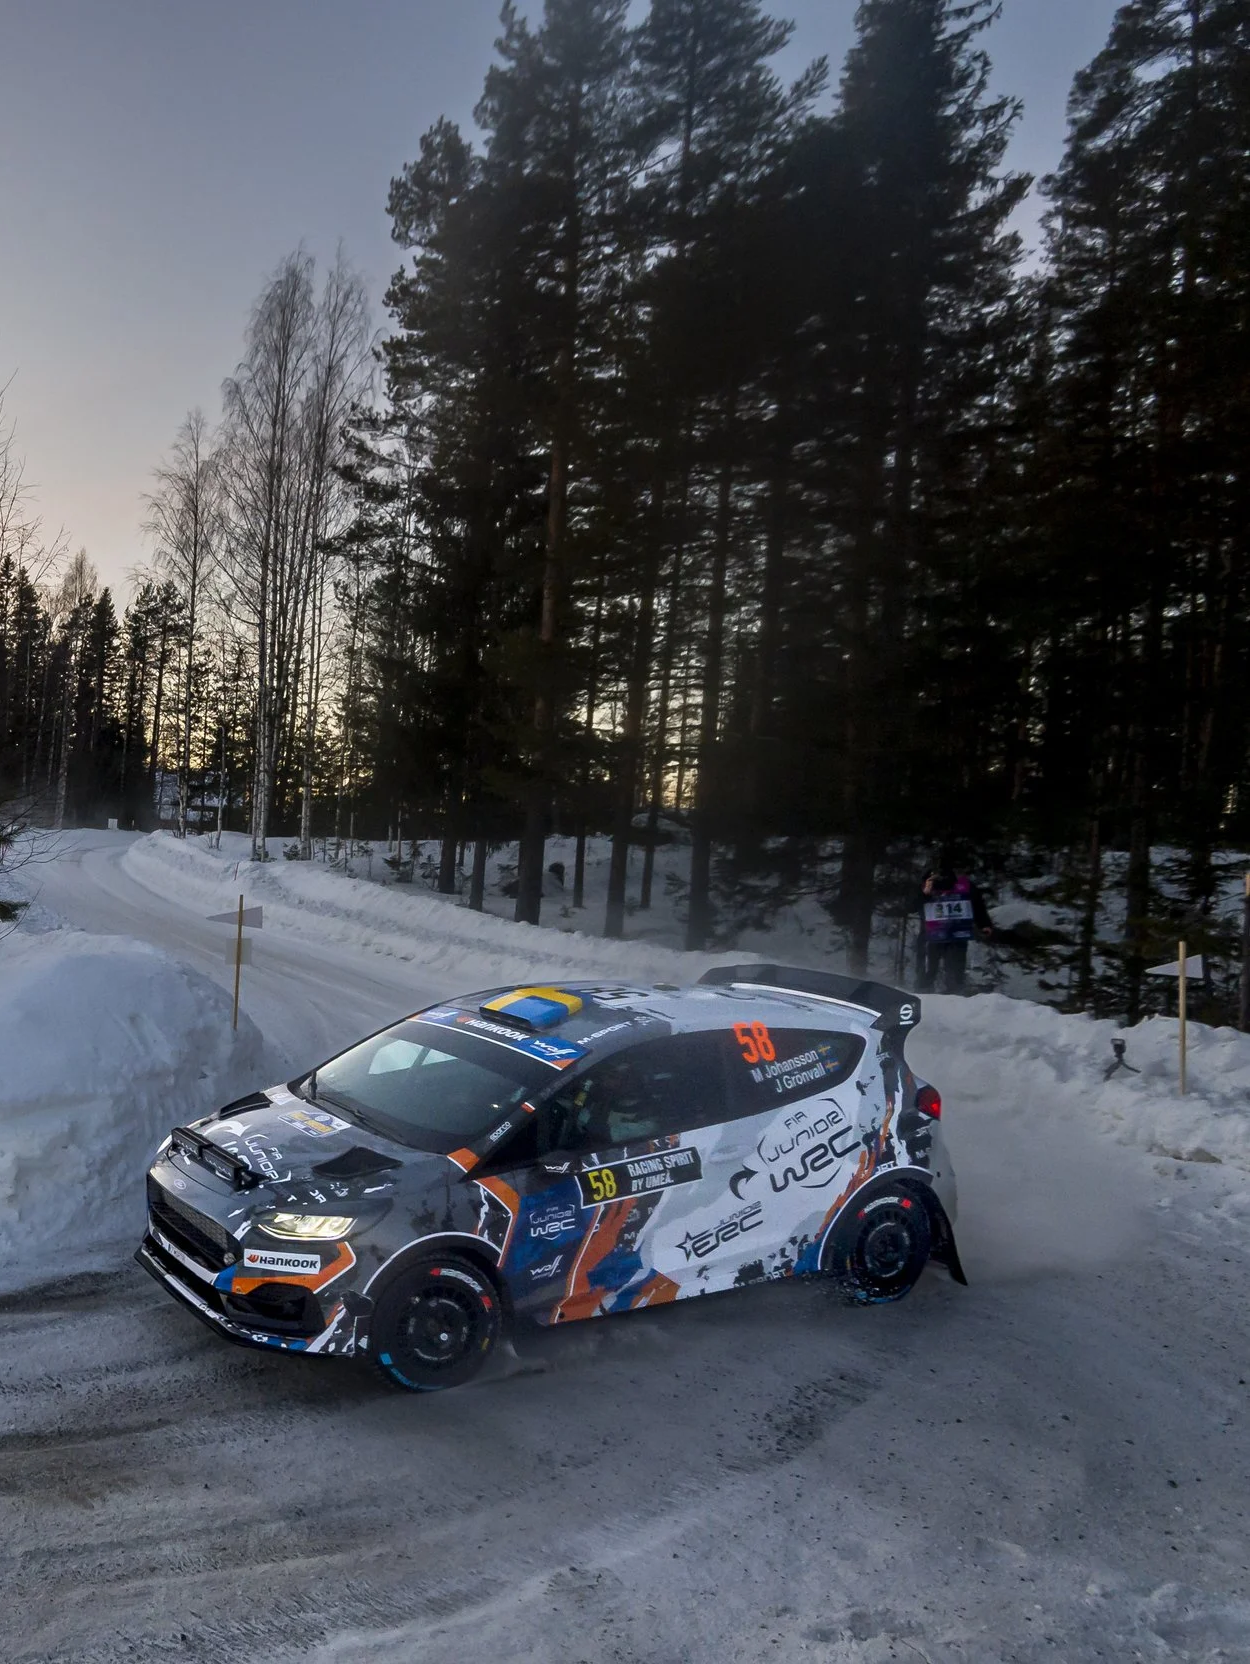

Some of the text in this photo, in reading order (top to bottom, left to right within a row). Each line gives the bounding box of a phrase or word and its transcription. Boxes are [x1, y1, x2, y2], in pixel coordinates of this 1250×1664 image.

[733, 1020, 776, 1064] 58
[750, 1050, 819, 1084] M Johansson
[776, 1062, 826, 1093] J Grönvall
[766, 1110, 843, 1162] JUNIOR
[784, 1111, 808, 1130] FIA
[244, 1138, 280, 1182] JUNIOR
[271, 1146, 283, 1161] FIA
[626, 1150, 695, 1177] RACING SPIRIT
[769, 1125, 861, 1193] WRC
[588, 1168, 617, 1201] 58
[631, 1178, 644, 1192] BY
[530, 1218, 576, 1238] WRC
[532, 1210, 574, 1224] JUNIOR
[716, 1200, 762, 1229] JUNIOR
[691, 1208, 764, 1258] ERC
